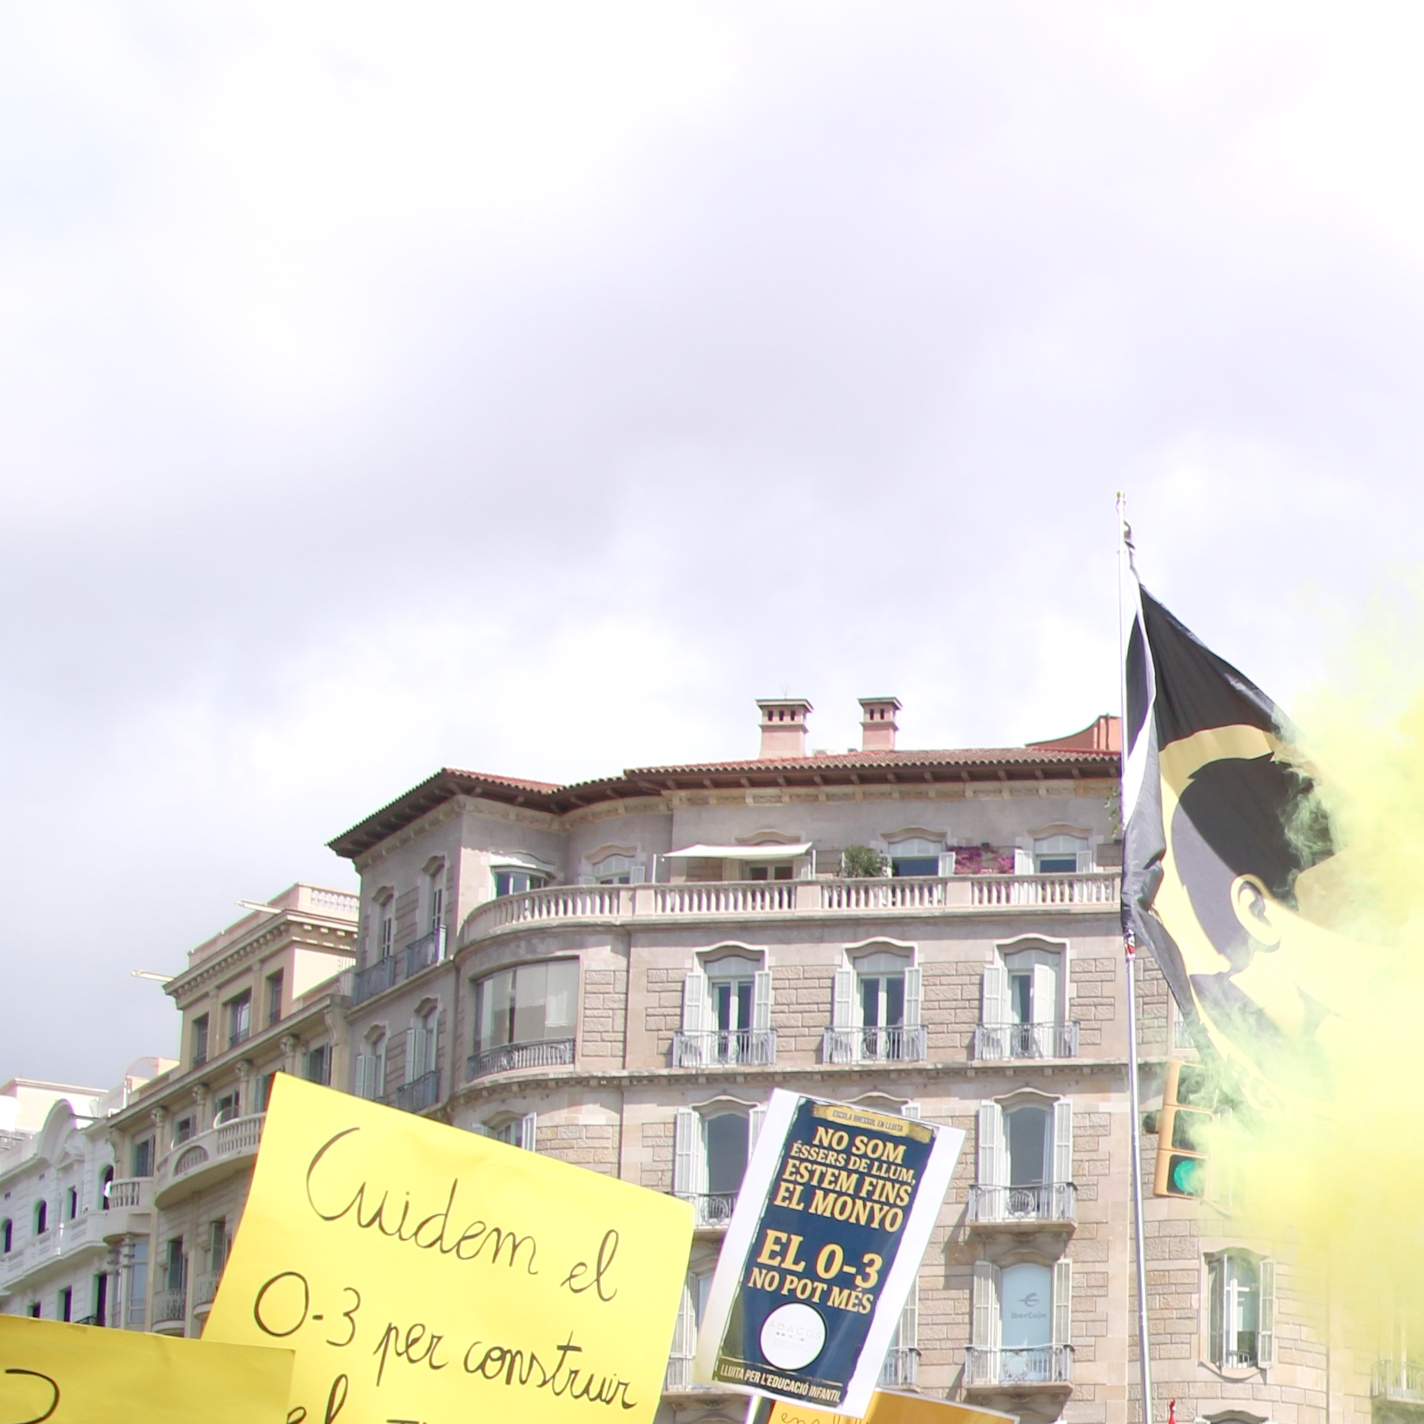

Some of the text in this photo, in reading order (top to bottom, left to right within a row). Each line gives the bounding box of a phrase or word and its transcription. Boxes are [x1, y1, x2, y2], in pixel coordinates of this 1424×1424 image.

[791, 1142, 916, 1185] ÉSSERS DE LLUM,
[813, 1126, 906, 1165] NO SOM
[783, 1160, 913, 1206] ESTEM FINS
[306, 1127, 617, 1301] Cuidem el
[773, 1183, 904, 1232] EL MONYO
[757, 1229, 883, 1289] EL 0-3
[748, 1267, 874, 1315] NO POT MÉS
[373, 1320, 448, 1386] per
[462, 1330, 637, 1409] construir
[720, 1364, 840, 1402] LLUITA PER L'EDUCACIÓ INFANTIL
